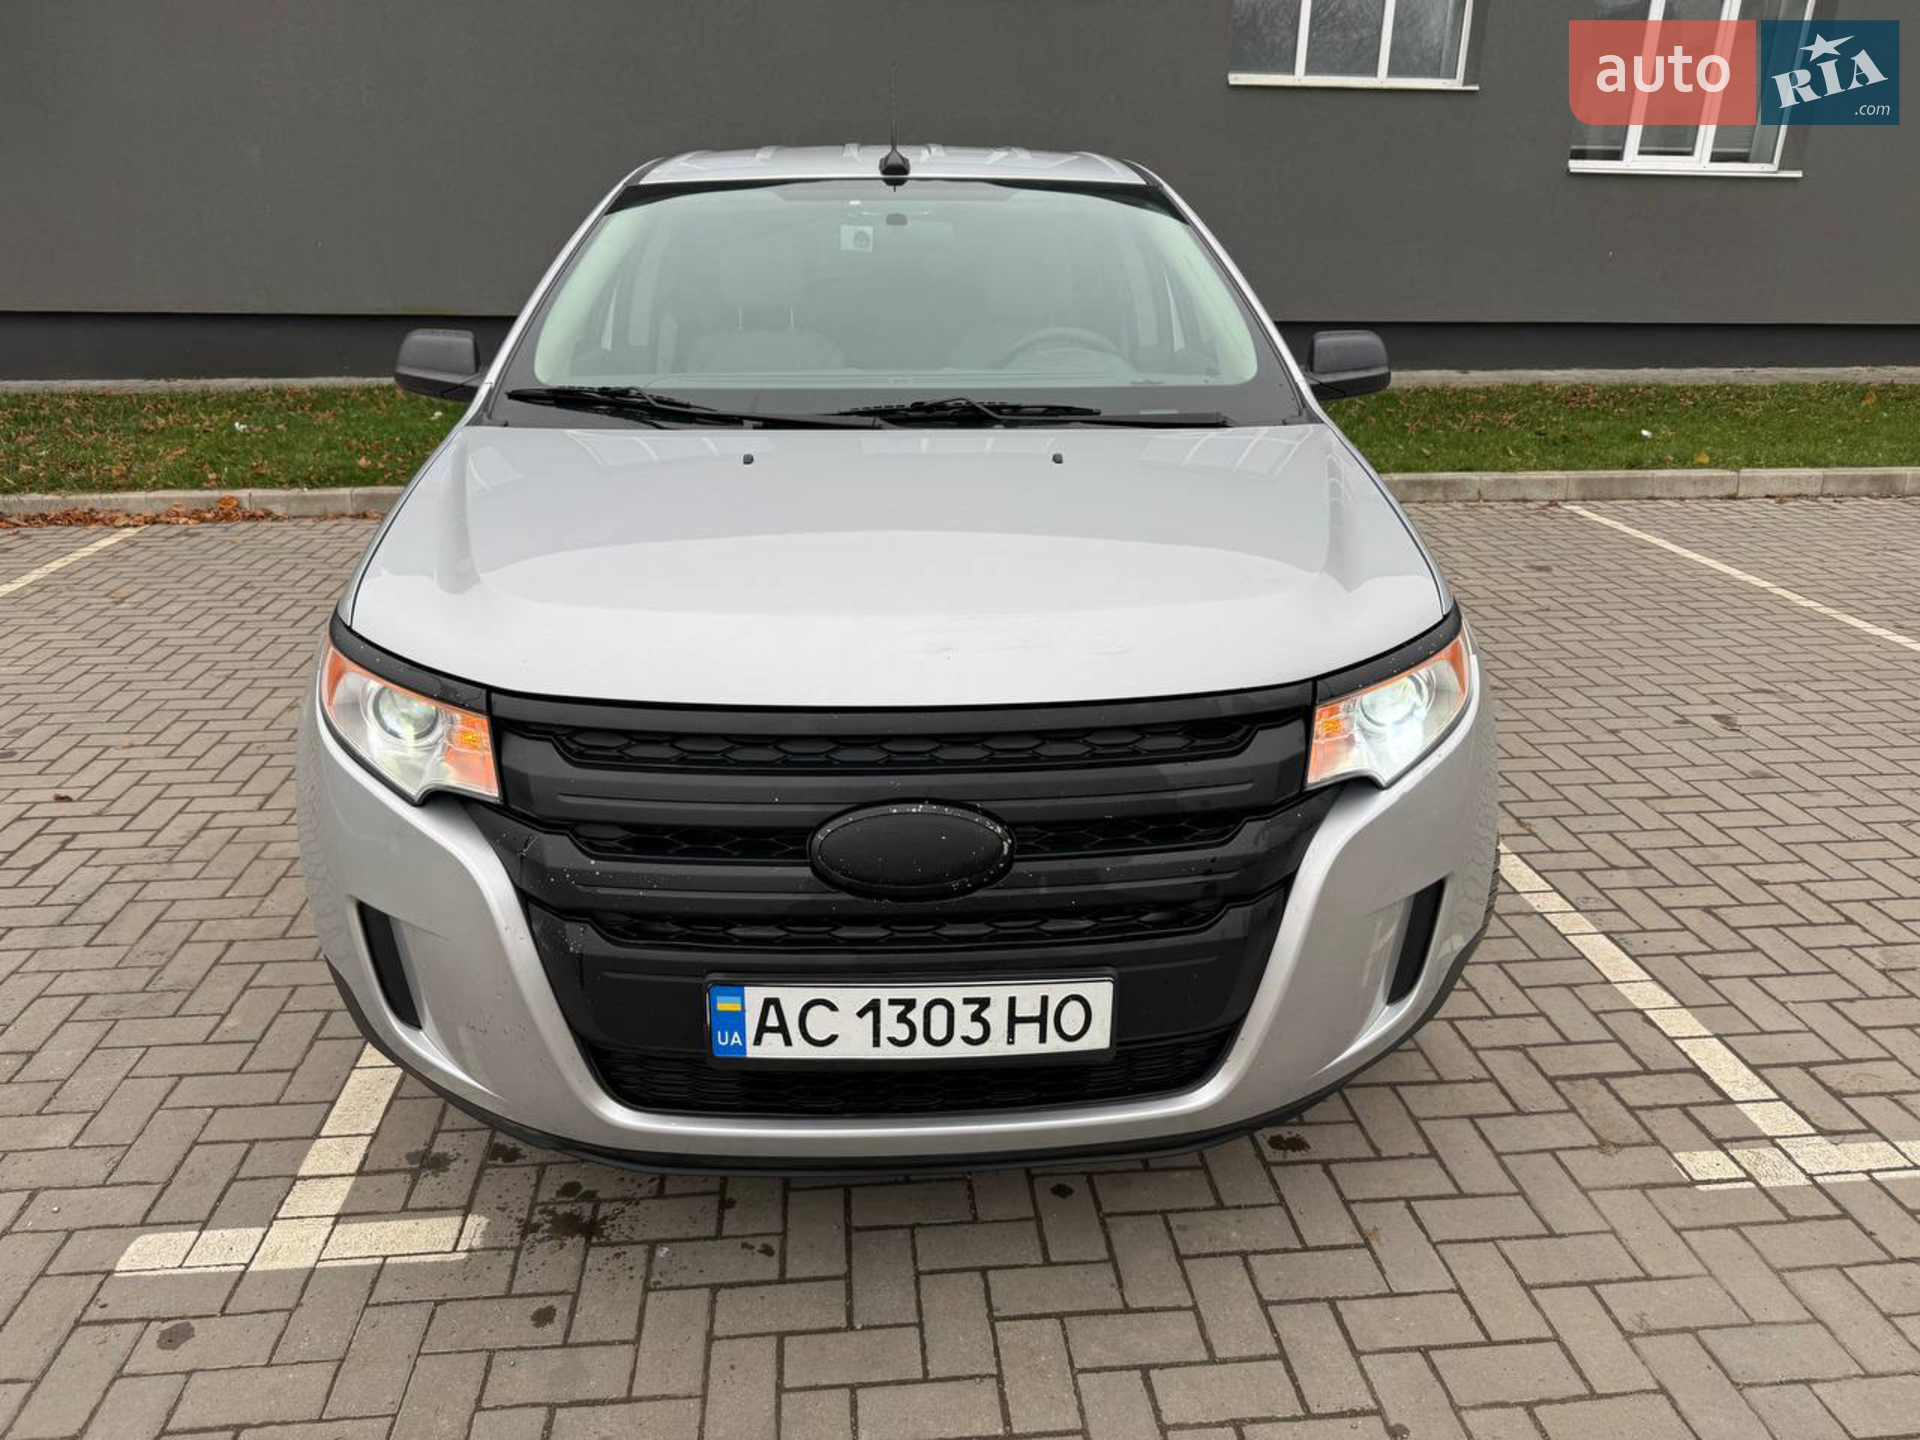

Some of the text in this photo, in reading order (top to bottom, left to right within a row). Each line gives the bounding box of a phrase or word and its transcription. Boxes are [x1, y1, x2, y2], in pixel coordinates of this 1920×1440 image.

[752, 993, 1093, 1047] AC 1303 HO
[717, 1031, 743, 1046] UA
